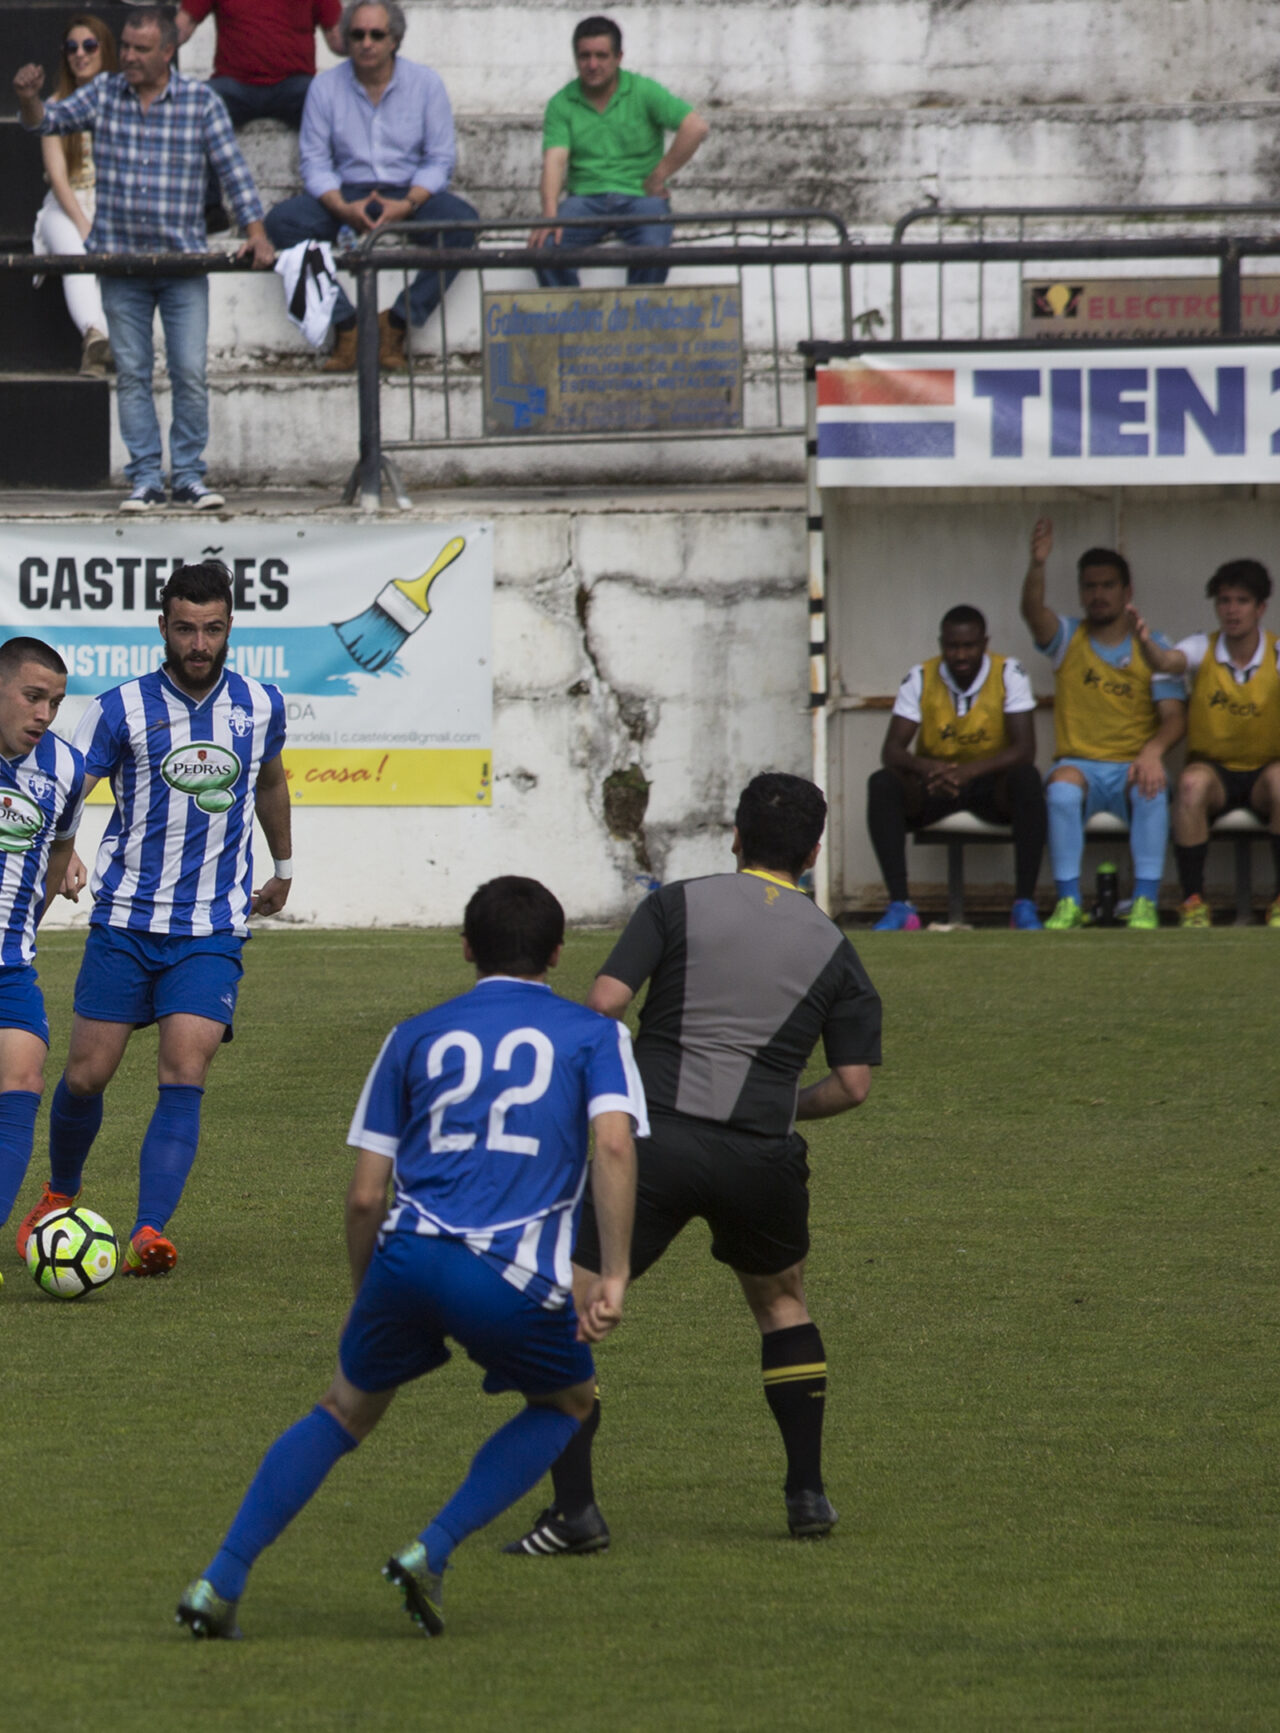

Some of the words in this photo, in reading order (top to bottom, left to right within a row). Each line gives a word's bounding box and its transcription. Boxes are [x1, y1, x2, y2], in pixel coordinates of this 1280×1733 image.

[971, 366, 1246, 458] TIEN
[19, 546, 289, 611] CASTEES
[287, 703, 316, 721] DA
[173, 762, 232, 776] PEDRAS
[305, 753, 390, 783] casa!
[426, 1026, 555, 1157] 22
